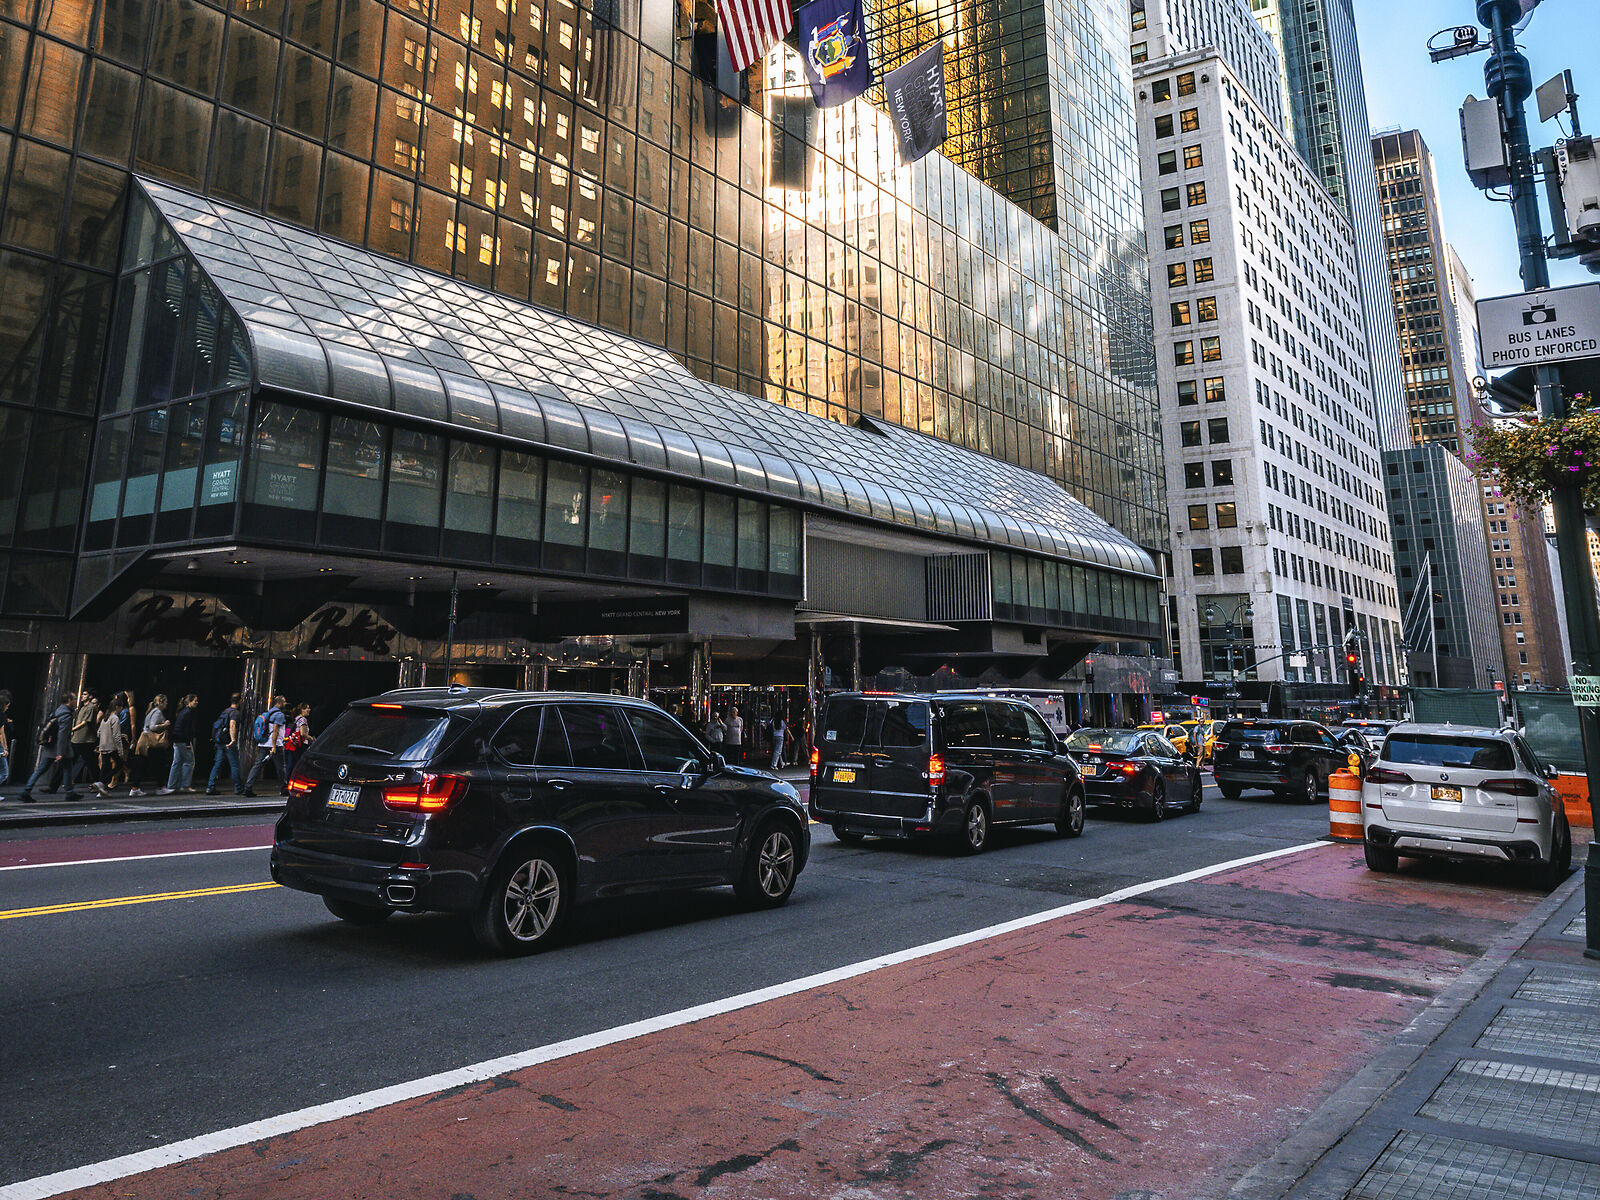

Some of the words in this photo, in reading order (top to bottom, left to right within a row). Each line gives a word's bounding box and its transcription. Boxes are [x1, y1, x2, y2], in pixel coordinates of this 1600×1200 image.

[894, 88, 906, 113] NEW
[900, 113, 913, 143] YORK
[1508, 332, 1532, 345] BUS
[1537, 326, 1576, 341] LANES
[1492, 348, 1530, 362] PHOTO
[1535, 339, 1597, 357] ENFORCED
[213, 470, 231, 479] HYATT
[271, 473, 297, 483] HYATT
[212, 479, 230, 487] GRAND
[1575, 676, 1587, 685] NO
